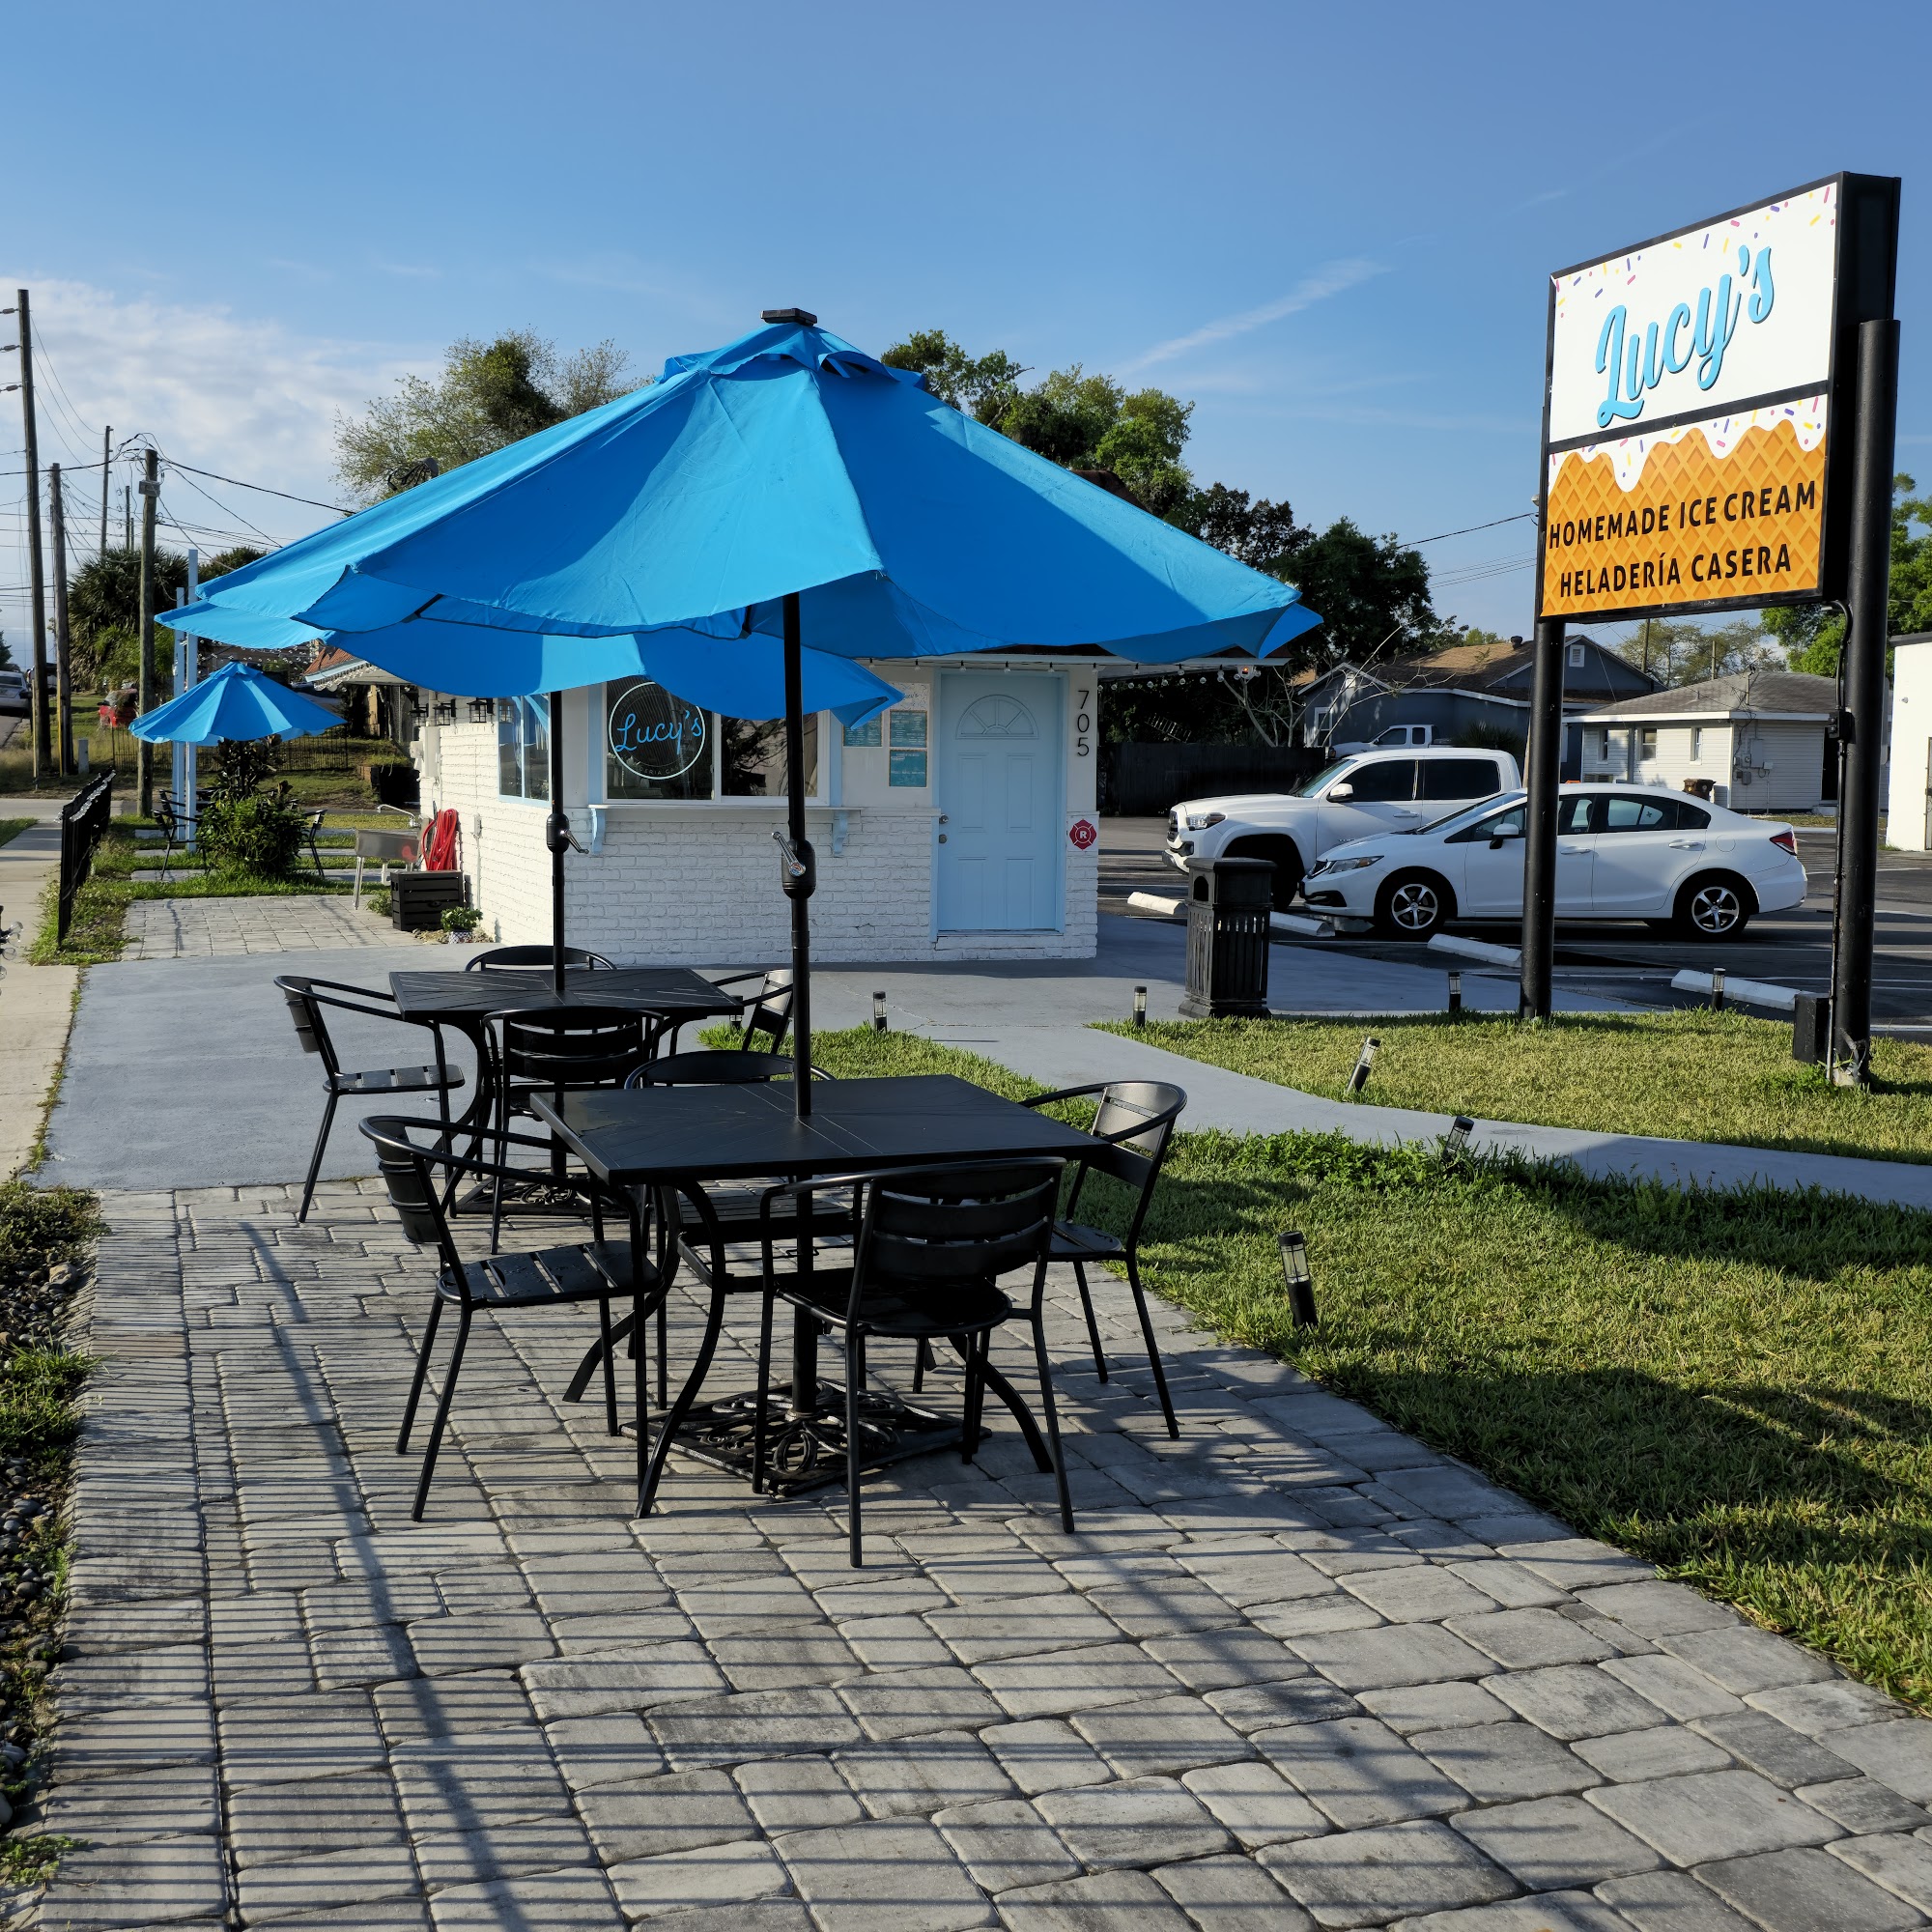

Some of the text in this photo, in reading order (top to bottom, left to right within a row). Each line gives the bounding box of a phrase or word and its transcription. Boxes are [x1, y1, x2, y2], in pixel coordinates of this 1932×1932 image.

[1595, 244, 1776, 428] Lucy's
[1548, 481, 1815, 549] HOMEMADE ICE CREAM
[1560, 544, 1791, 598] HELADERÍA CASERA
[614, 709, 703, 755] Lucy's
[1079, 830, 1088, 839] R
